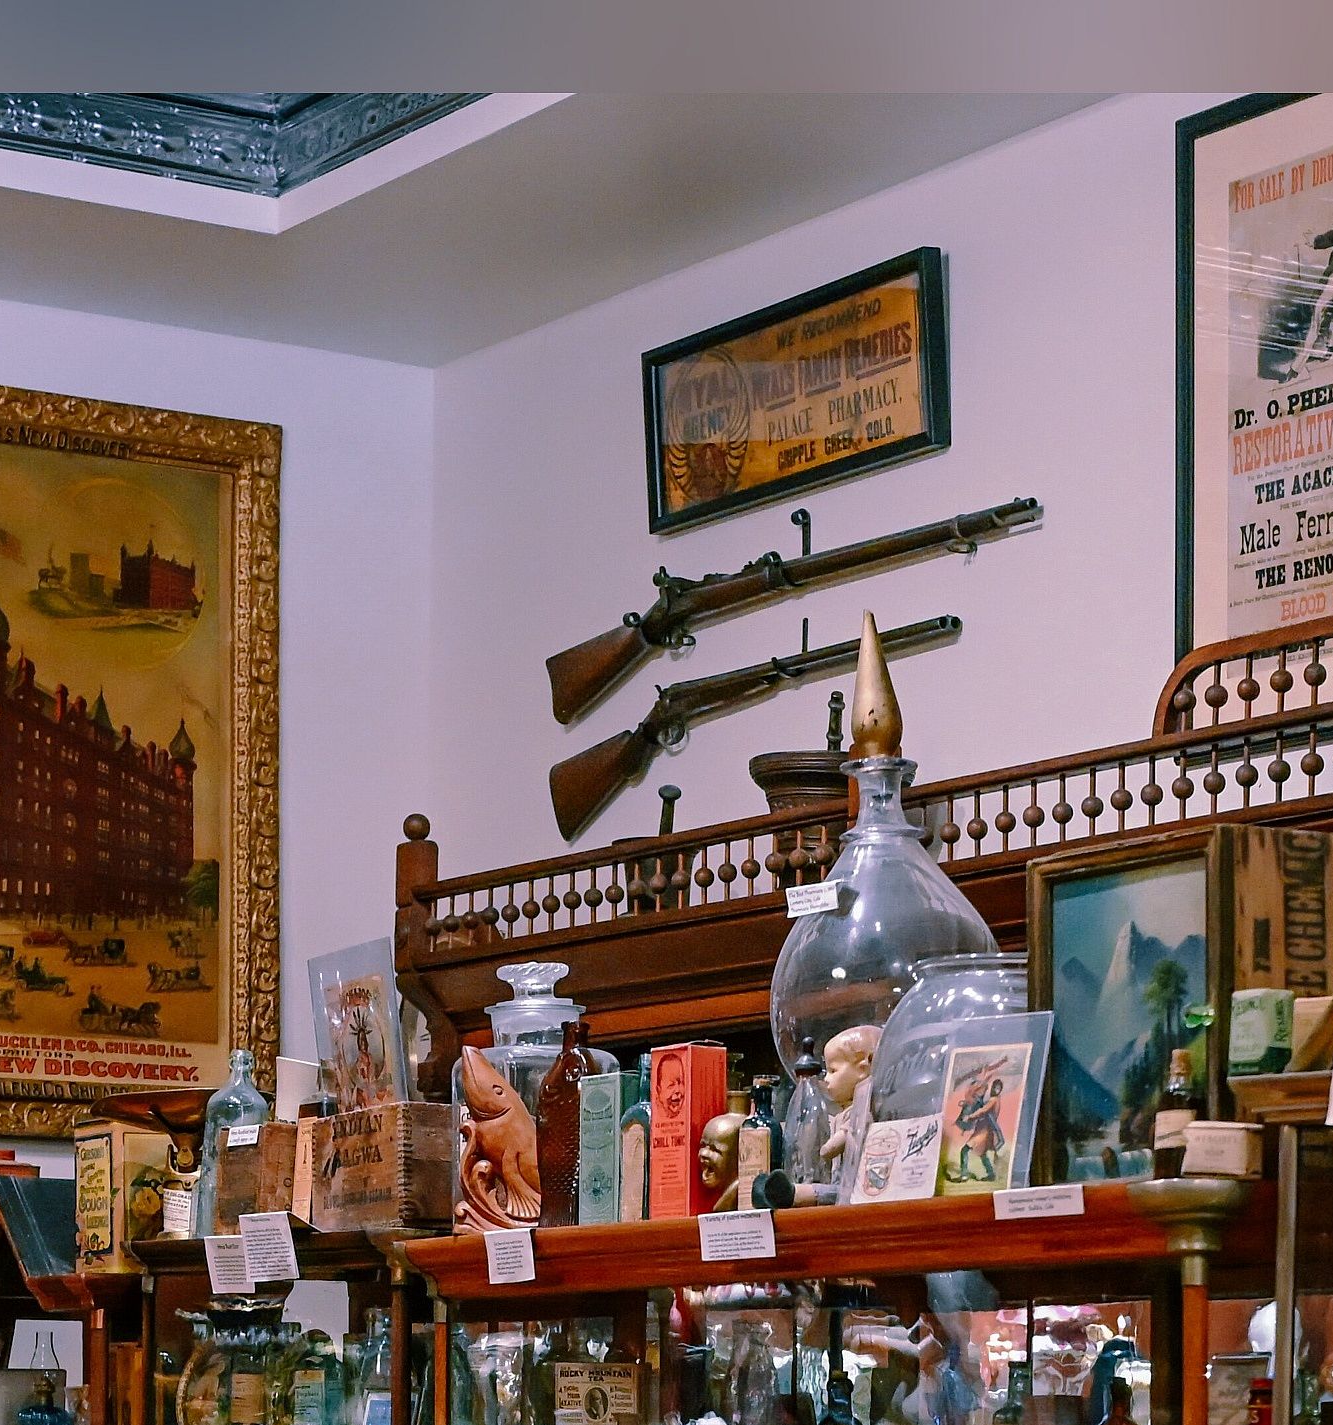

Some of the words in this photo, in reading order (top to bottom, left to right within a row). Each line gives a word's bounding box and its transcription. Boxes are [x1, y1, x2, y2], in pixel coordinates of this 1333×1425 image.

[1234, 181, 1255, 214] FOR
[1259, 171, 1285, 205] SALE
[1290, 167, 1306, 195] BY
[768, 407, 813, 445] PALACE
[1234, 407, 1258, 431] Dr.
[1267, 399, 1283, 419] O.
[1255, 478, 1285, 505] THE
[1240, 520, 1281, 556] Male
[1255, 563, 1286, 590] THE
[1280, 592, 1325, 621] BLOOD
[44, 1058, 199, 1082] DISCOVERY.
